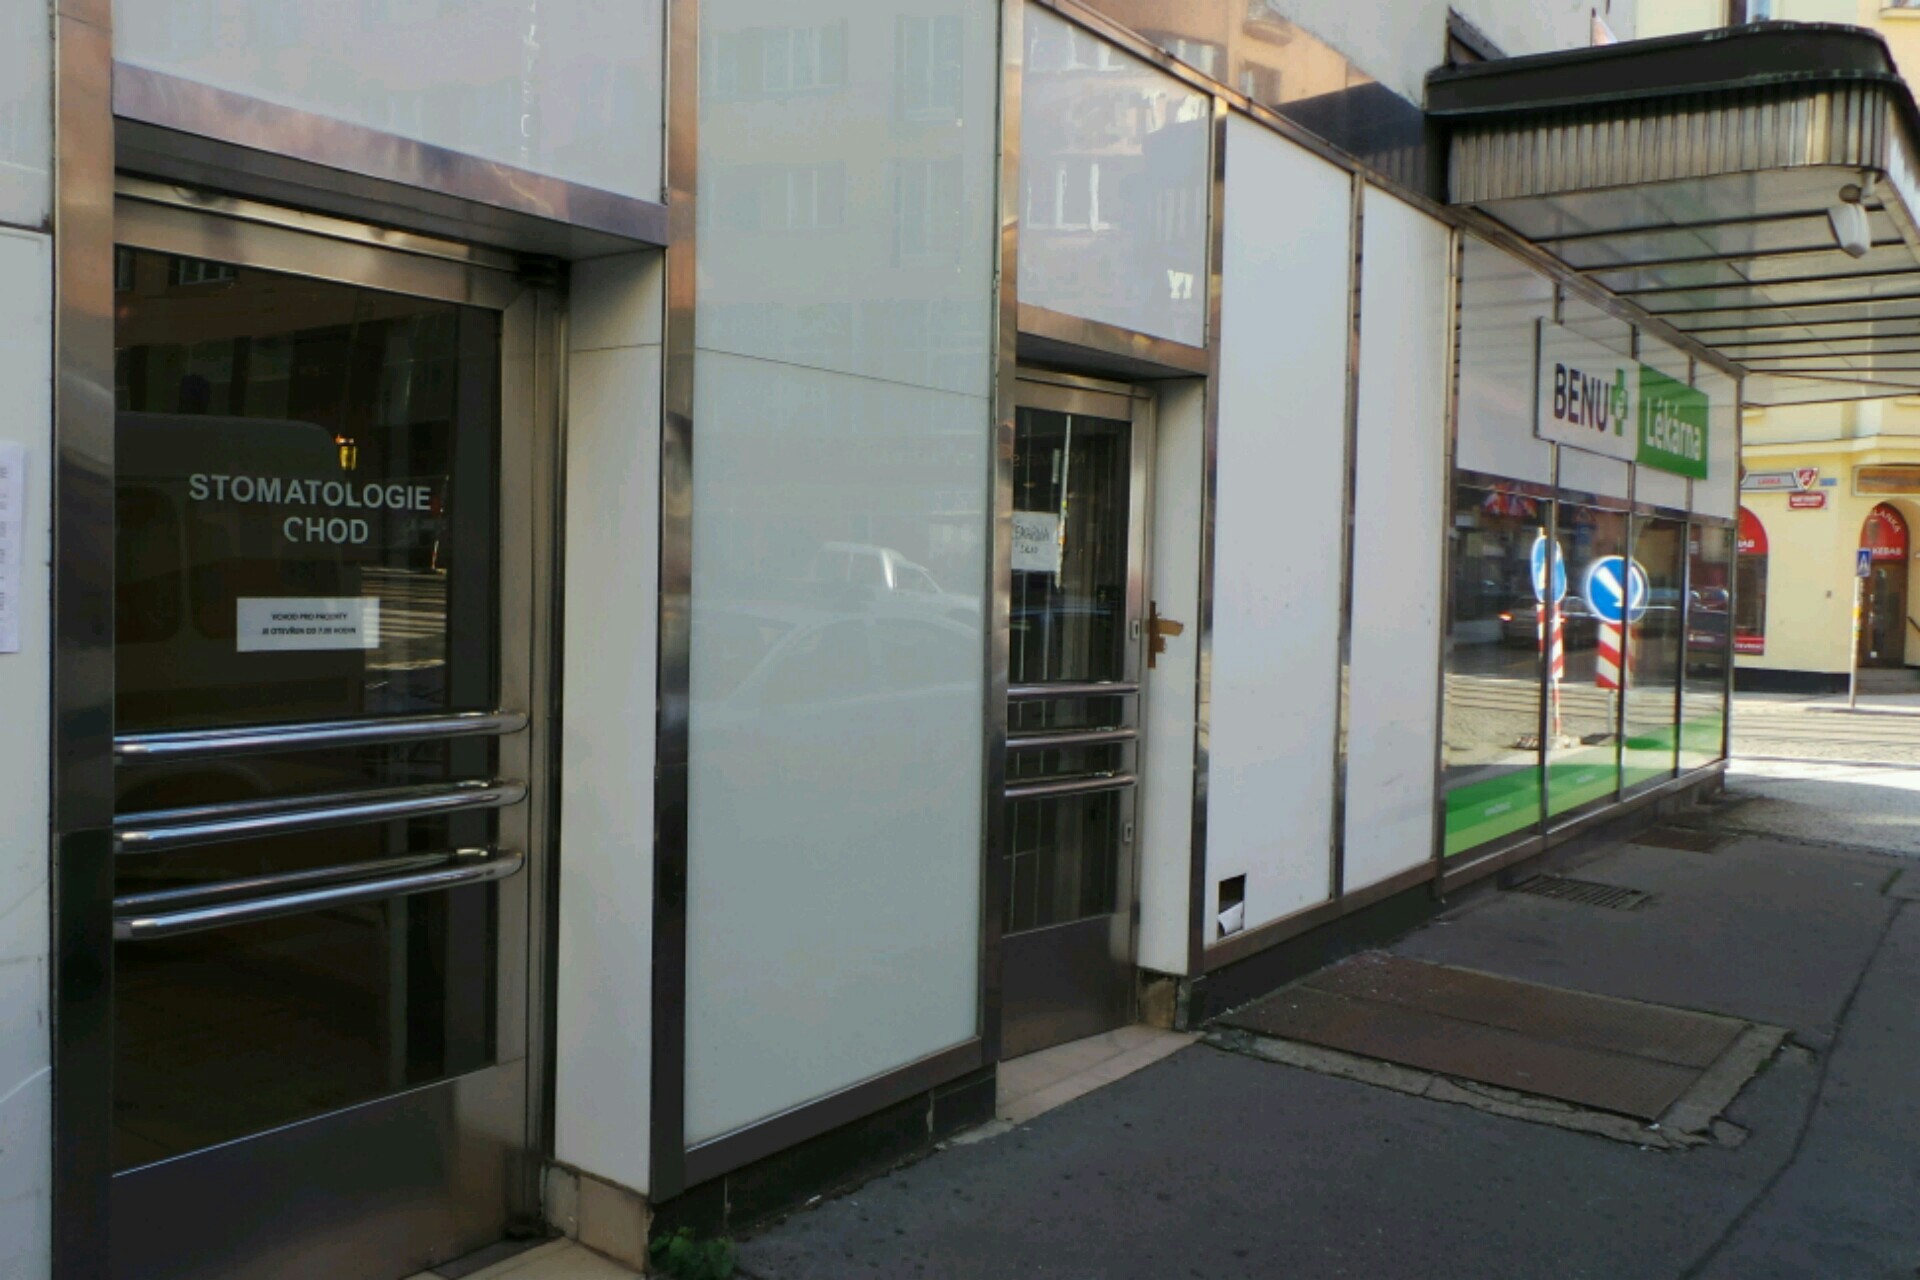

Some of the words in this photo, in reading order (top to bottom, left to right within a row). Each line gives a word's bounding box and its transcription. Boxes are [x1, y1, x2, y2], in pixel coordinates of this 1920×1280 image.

[1554, 363, 1609, 432] BENU
[1645, 395, 1702, 462] Lékárna
[188, 473, 432, 511] STOMATOLOGIE
[282, 516, 369, 544] CHOD
